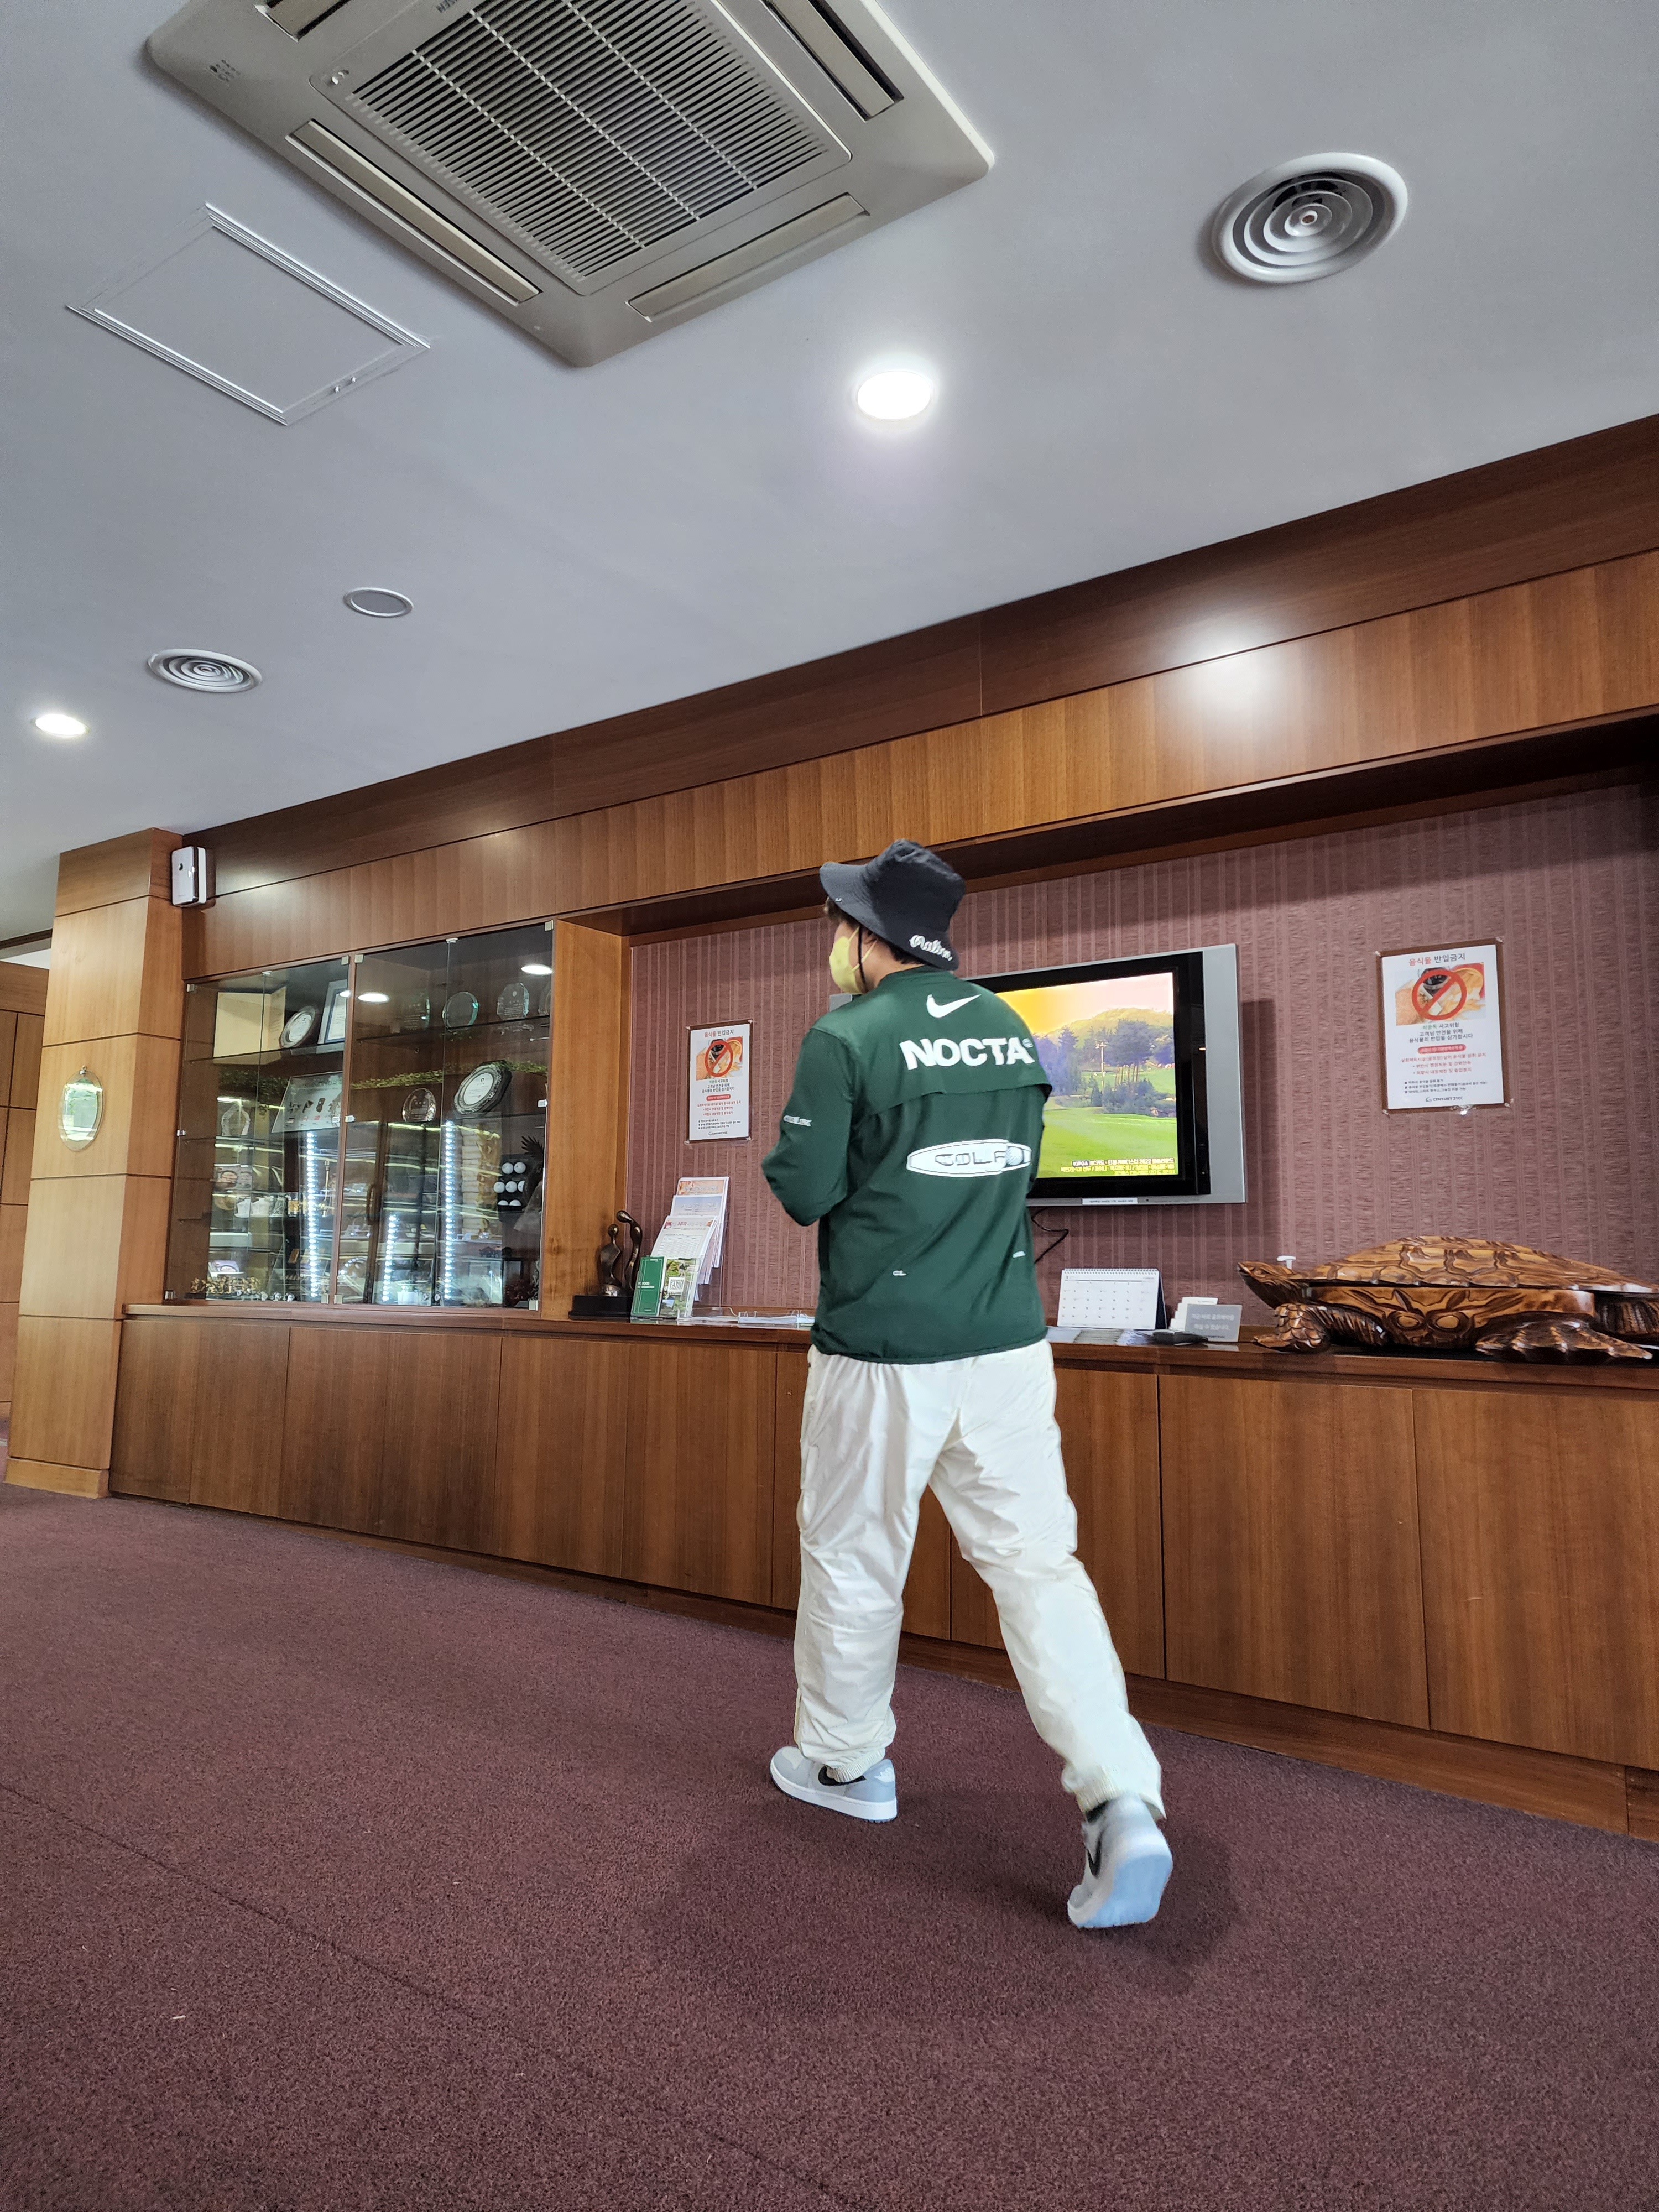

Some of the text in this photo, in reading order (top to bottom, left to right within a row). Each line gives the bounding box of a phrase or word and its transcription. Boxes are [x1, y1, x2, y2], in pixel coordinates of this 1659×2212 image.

[1408, 953, 1465, 966] 음식물 반입금지
[899, 1037, 1036, 1070] NOCTA
[935, 1150, 1006, 1166] GOLF
